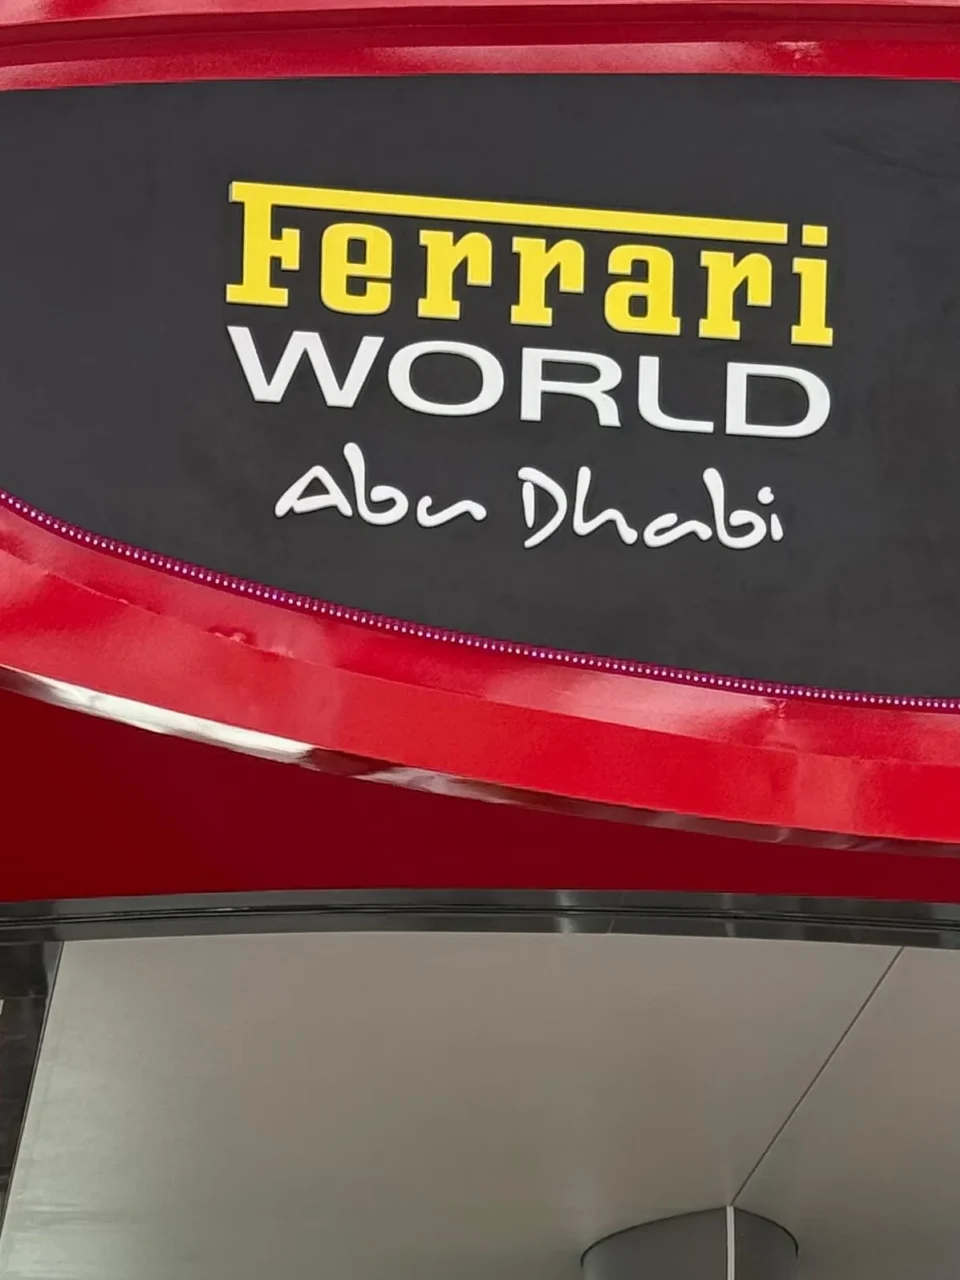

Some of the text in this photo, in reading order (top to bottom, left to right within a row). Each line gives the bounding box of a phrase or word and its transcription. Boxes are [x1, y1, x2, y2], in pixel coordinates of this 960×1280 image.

[226, 181, 833, 346] Ferrari
[226, 325, 832, 438] WORLD
[275, 442, 785, 550] Abu Dhabi
